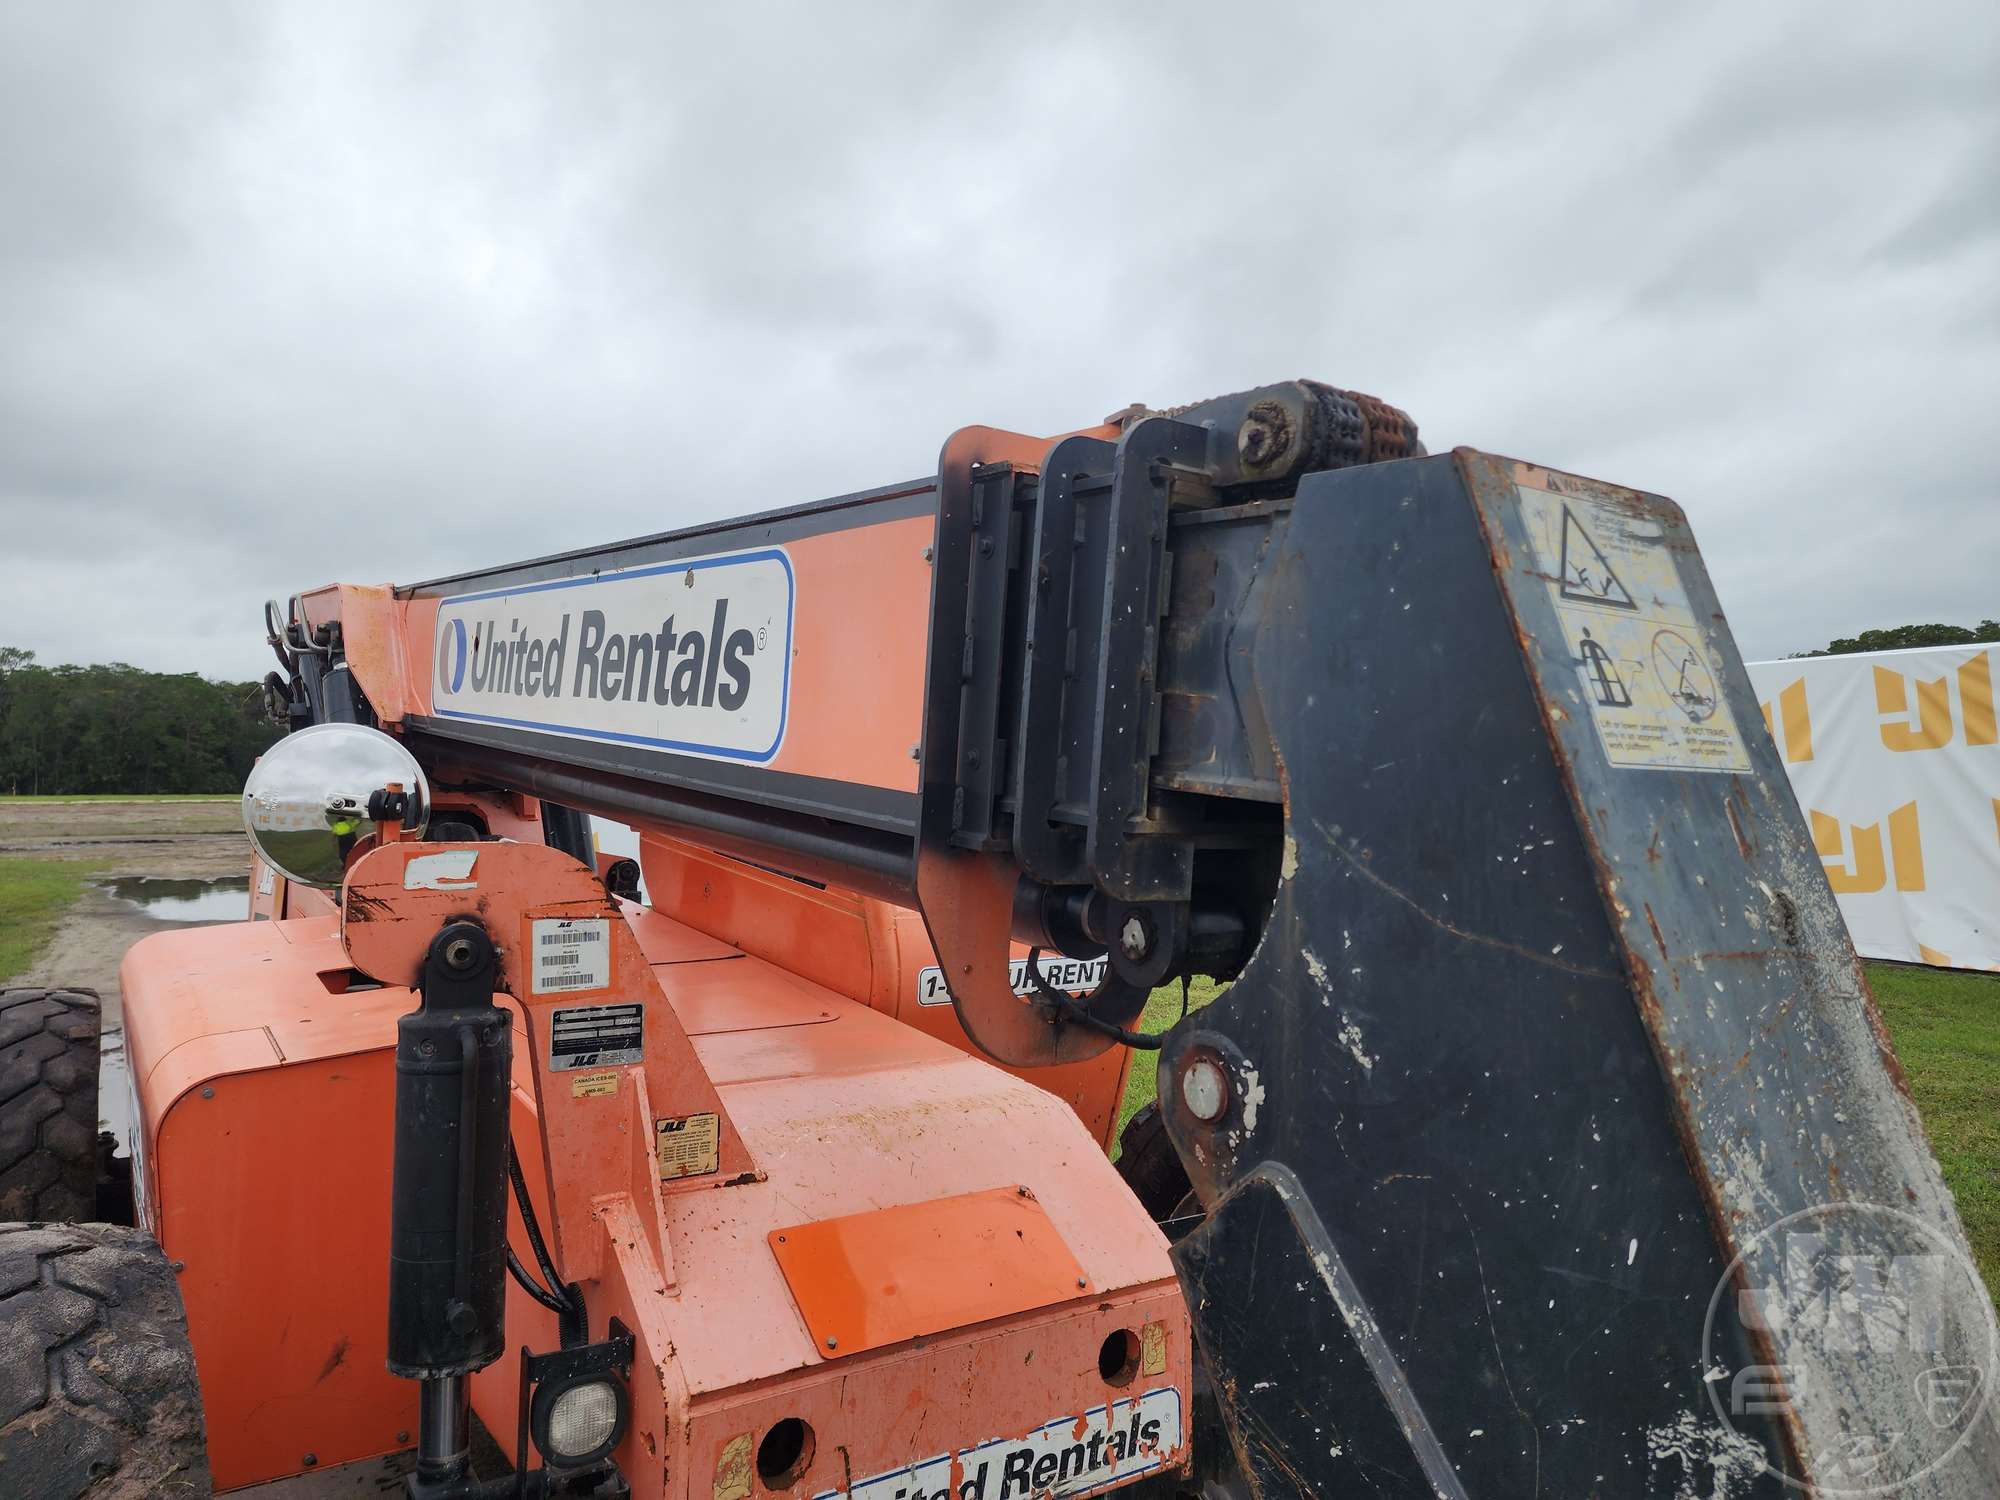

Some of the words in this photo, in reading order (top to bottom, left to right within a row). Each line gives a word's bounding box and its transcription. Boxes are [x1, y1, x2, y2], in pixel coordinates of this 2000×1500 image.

[471, 614, 570, 697] United
[573, 598, 755, 711] Rentals
[568, 1054, 600, 1068] JLG
[660, 1120, 687, 1133] JLG
[1000, 1412, 1161, 1500] Rentals
